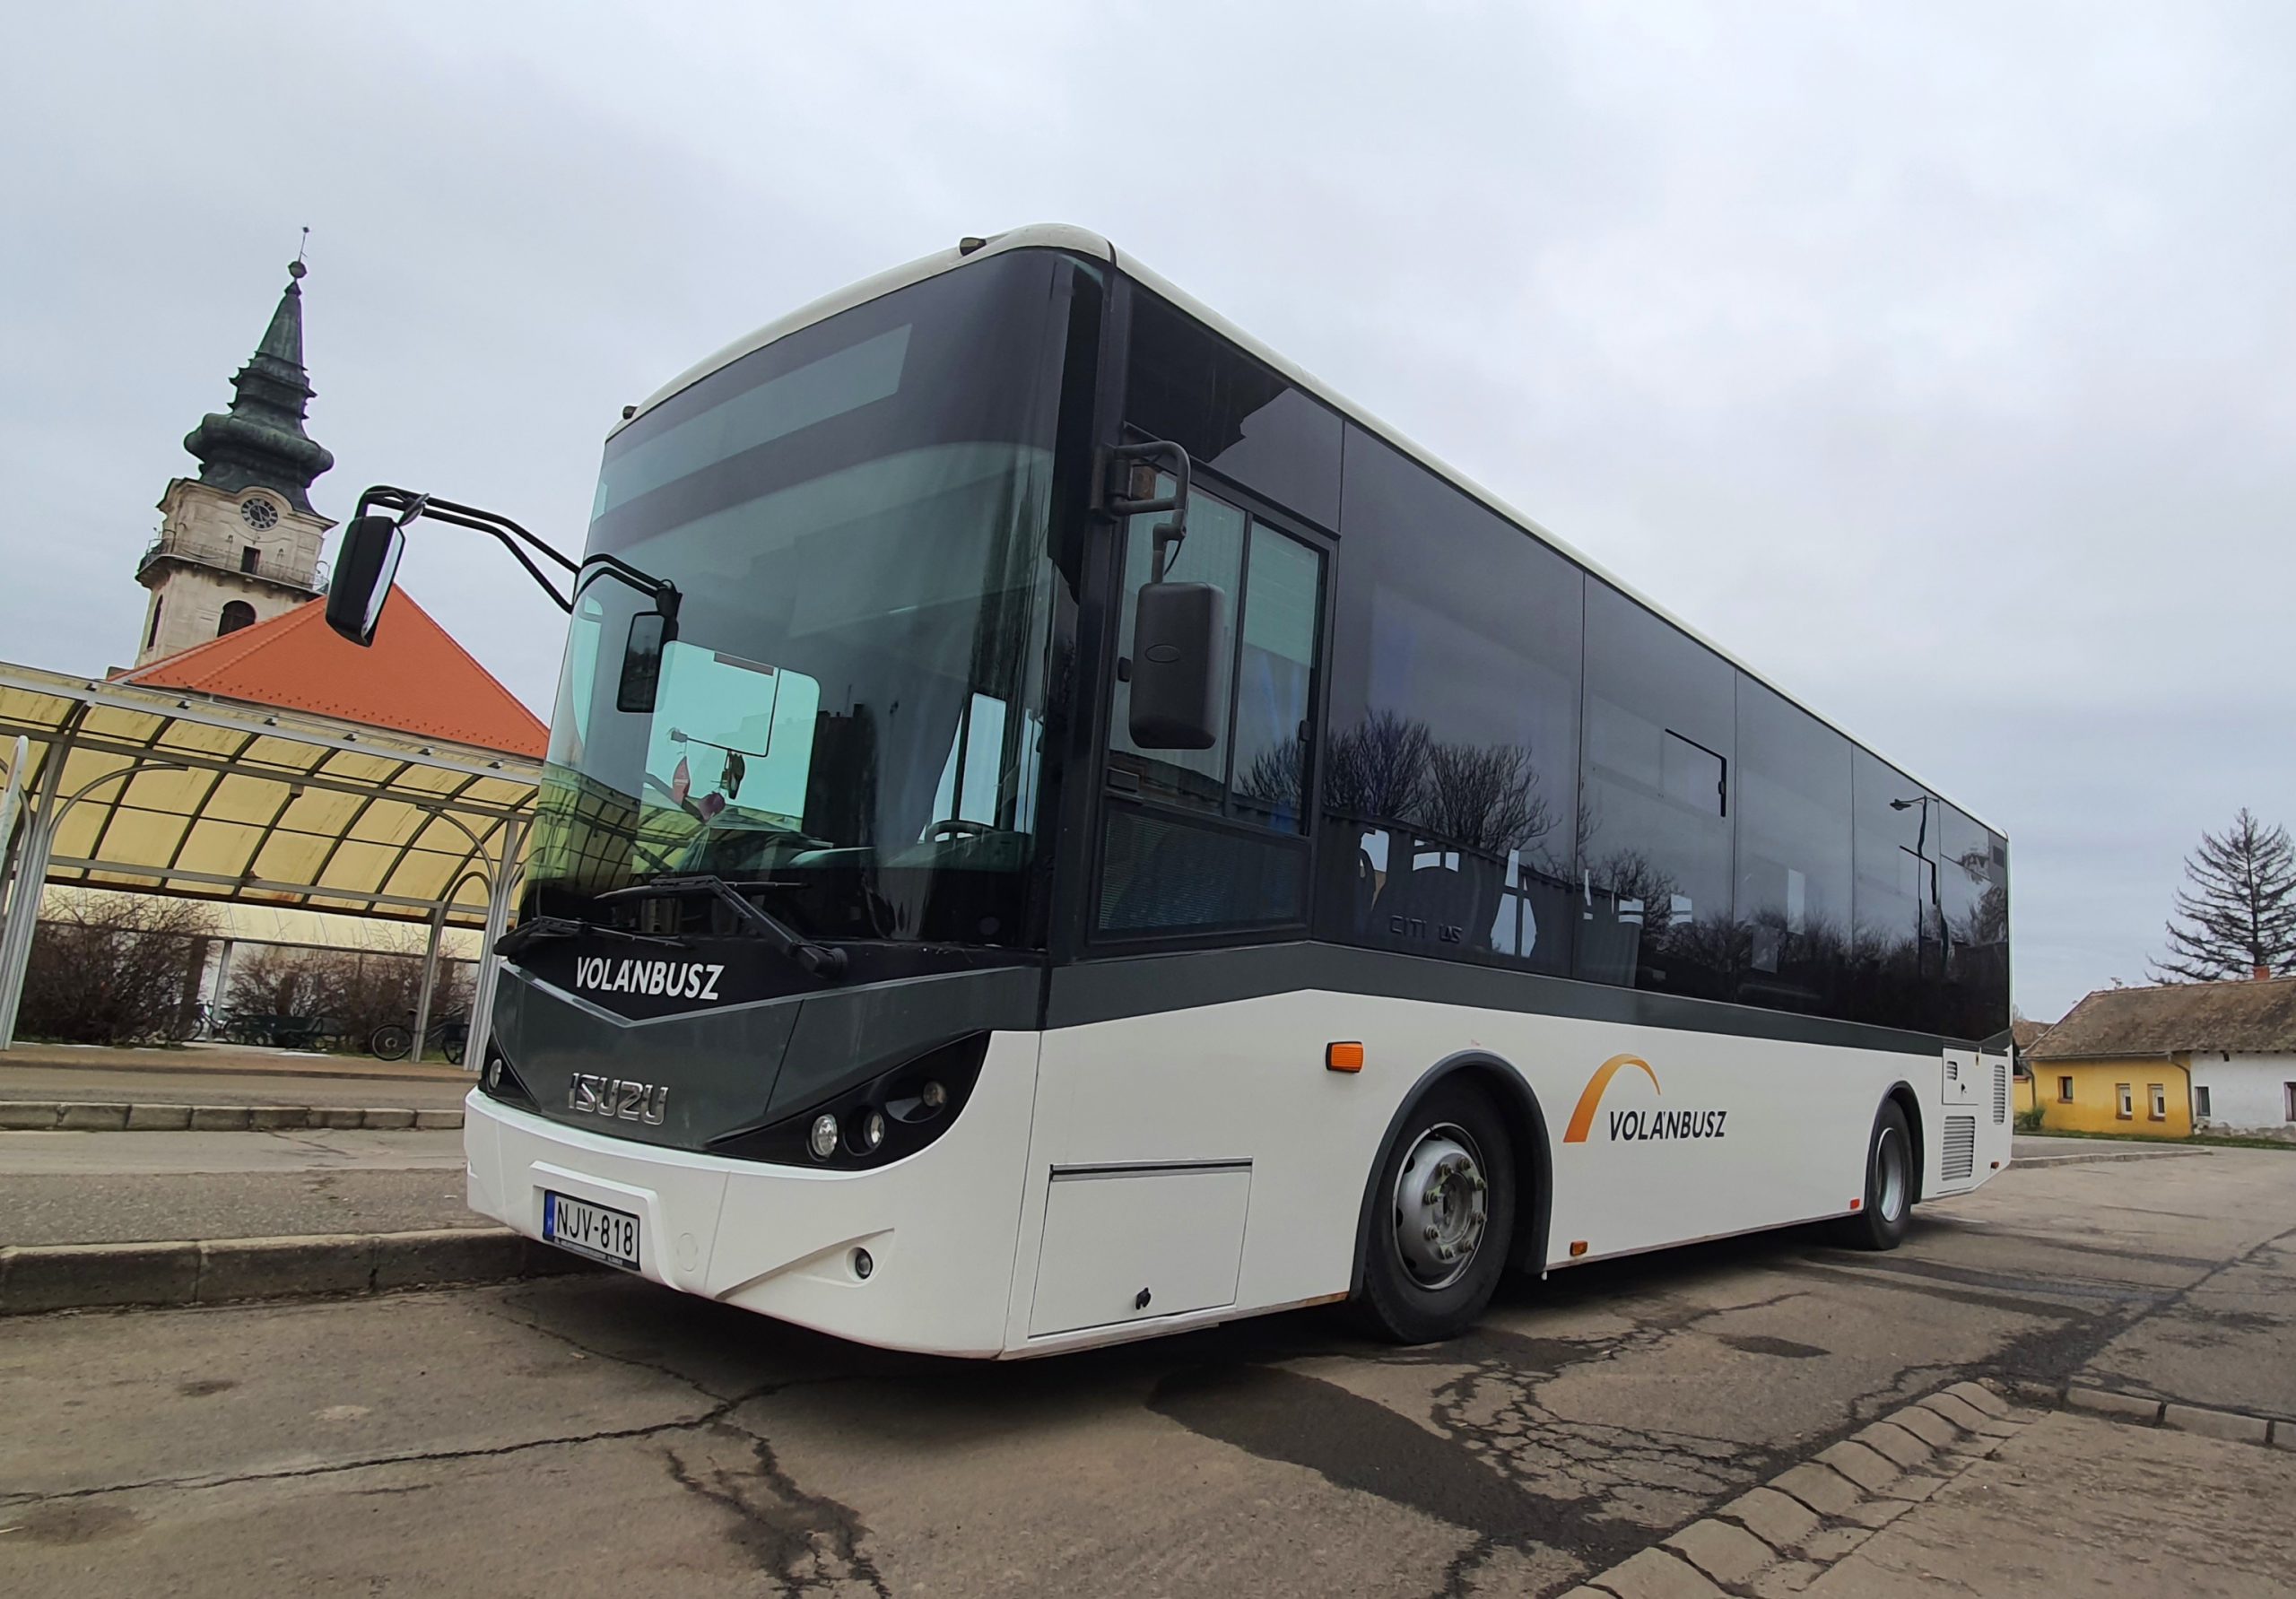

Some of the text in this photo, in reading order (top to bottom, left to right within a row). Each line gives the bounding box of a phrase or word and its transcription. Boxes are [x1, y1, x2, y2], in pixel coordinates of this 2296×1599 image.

[576, 956, 725, 1001] VOLÁNBUSZ
[568, 1073, 669, 1126] ISUZU
[1610, 1110, 1728, 1142] VOLÁNBUSZ
[556, 1201, 633, 1257] NJV-818
